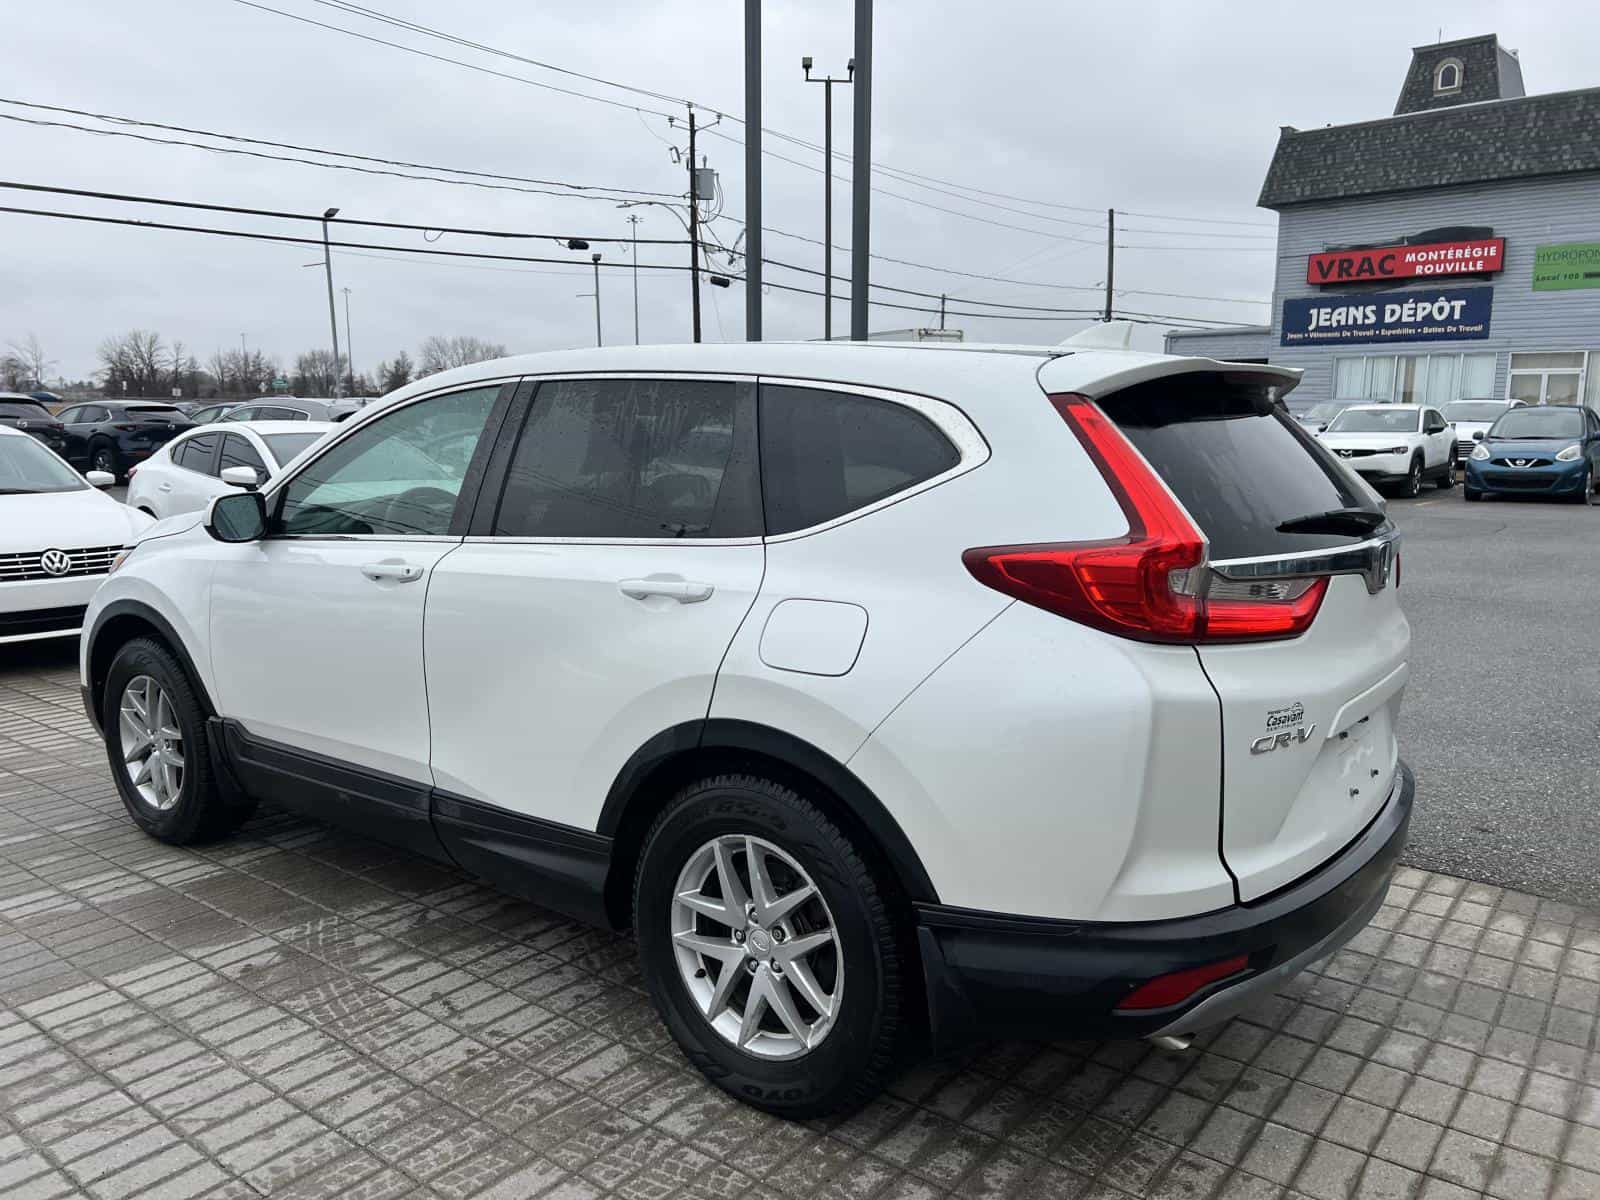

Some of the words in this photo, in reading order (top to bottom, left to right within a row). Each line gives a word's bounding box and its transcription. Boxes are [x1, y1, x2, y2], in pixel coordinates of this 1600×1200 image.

[1405, 246, 1497, 263] MONTÉRÉGIE
[1316, 254, 1396, 280] VRAC
[1415, 260, 1484, 275] ROUVILLE
[1308, 305, 1377, 330] JEANS
[1384, 296, 1467, 323] DÉPÔT
[1459, 324, 1483, 332] Travail
[1266, 711, 1304, 727] Casavant
[1250, 723, 1316, 755] CR-V
